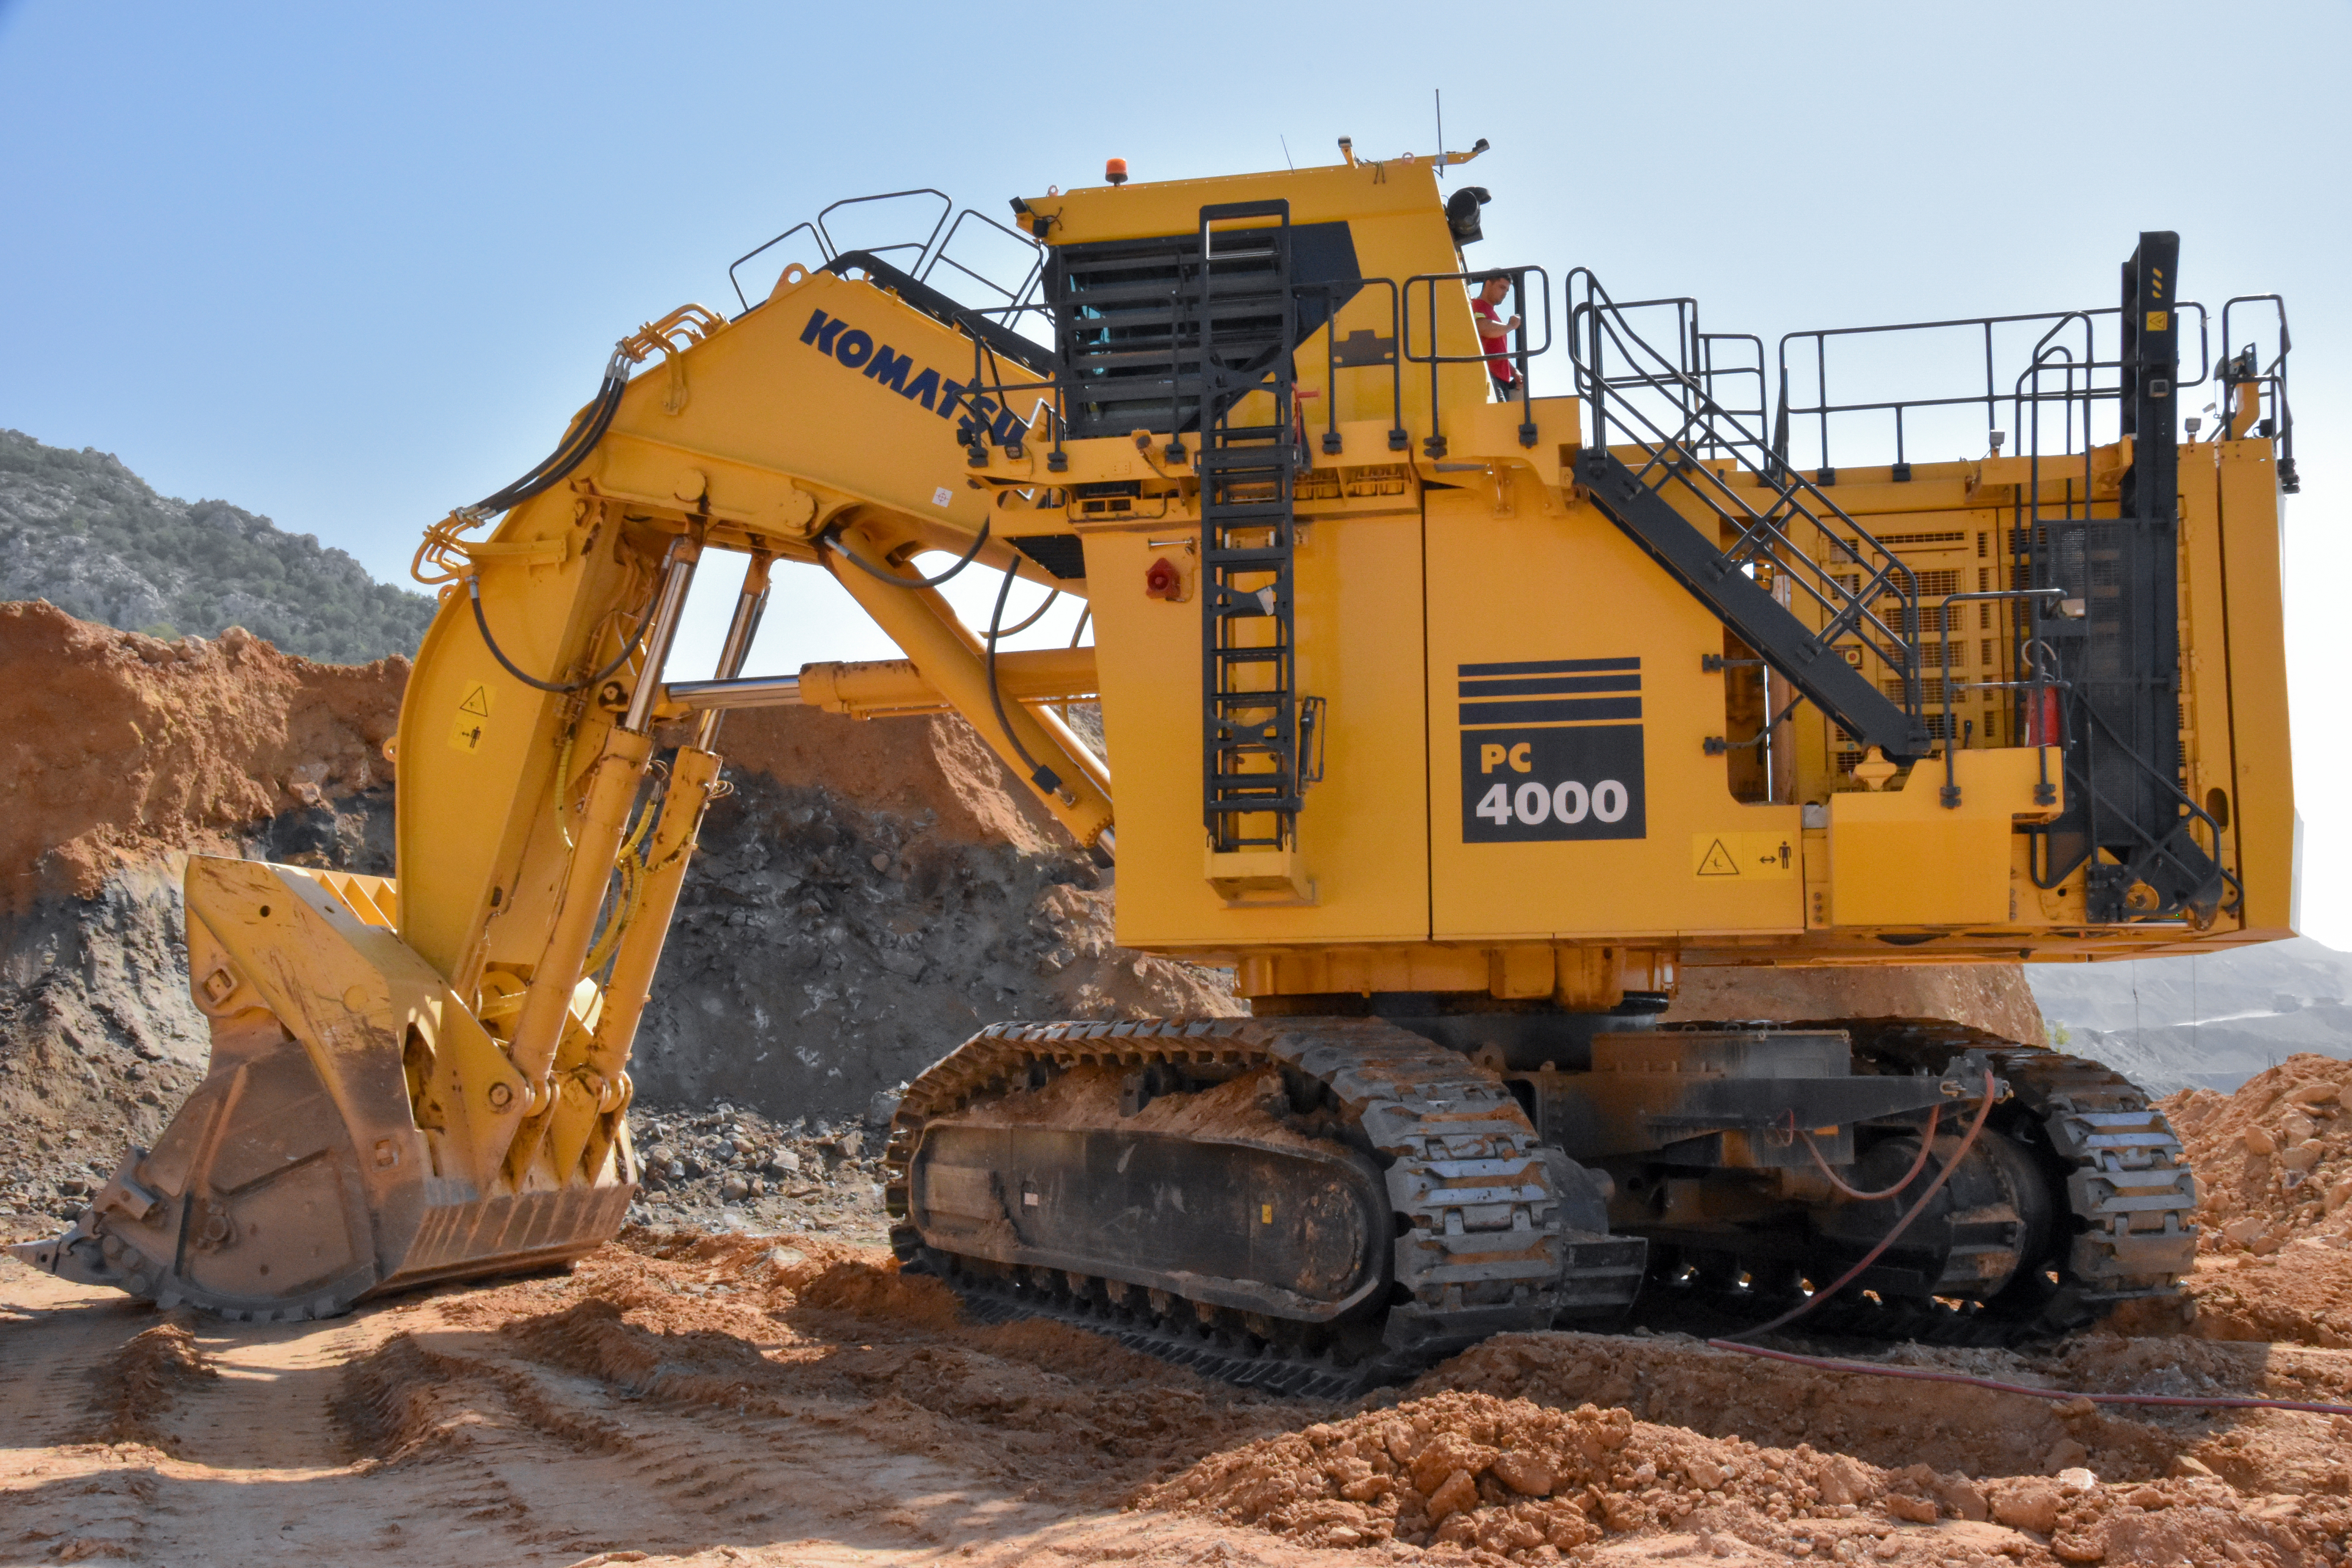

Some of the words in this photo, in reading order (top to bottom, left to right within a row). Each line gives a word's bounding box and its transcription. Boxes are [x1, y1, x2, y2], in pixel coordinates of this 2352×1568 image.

[799, 308, 1029, 446] KOMATSU
[1481, 742, 1532, 773] PC
[1476, 779, 1628, 825] 4000
